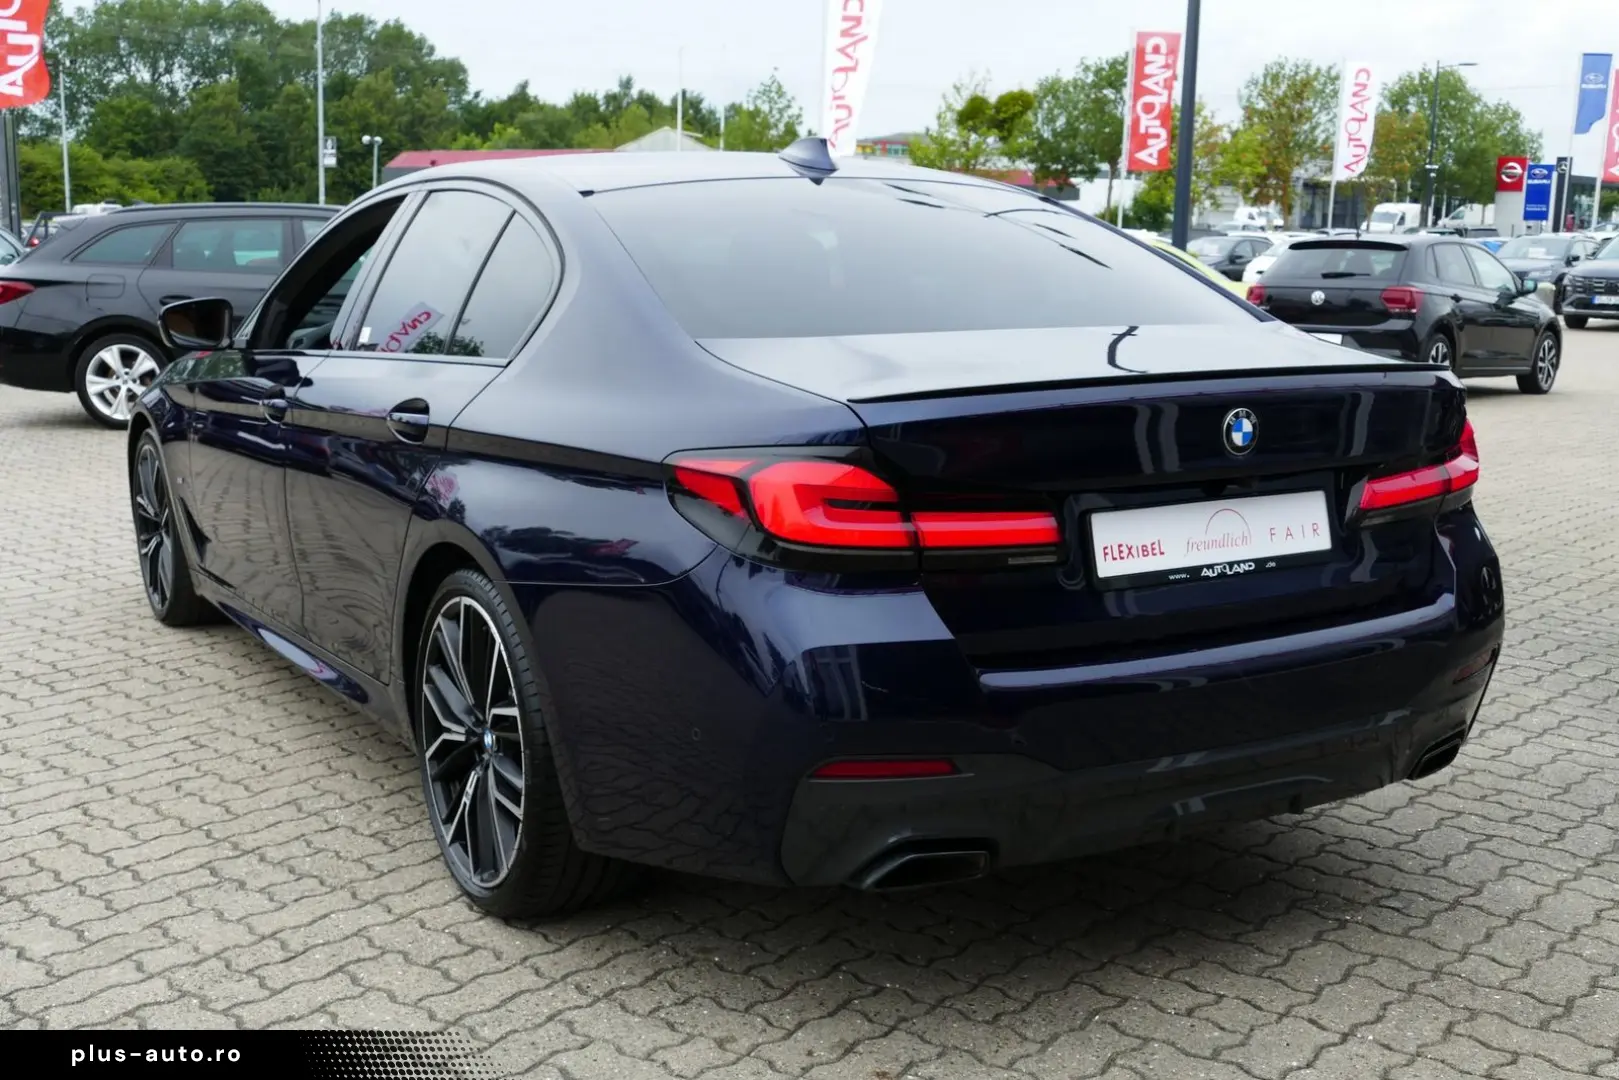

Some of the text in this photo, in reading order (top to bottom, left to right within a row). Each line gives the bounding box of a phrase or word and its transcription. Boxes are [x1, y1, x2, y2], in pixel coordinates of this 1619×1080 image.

[1134, 36, 1173, 166] AUTOLAND
[1344, 68, 1372, 173] AUTOLAND
[1103, 539, 1165, 562] FLEXIBEL
[1184, 531, 1248, 557] freundlich
[1201, 562, 1255, 577] AUTOLAND
